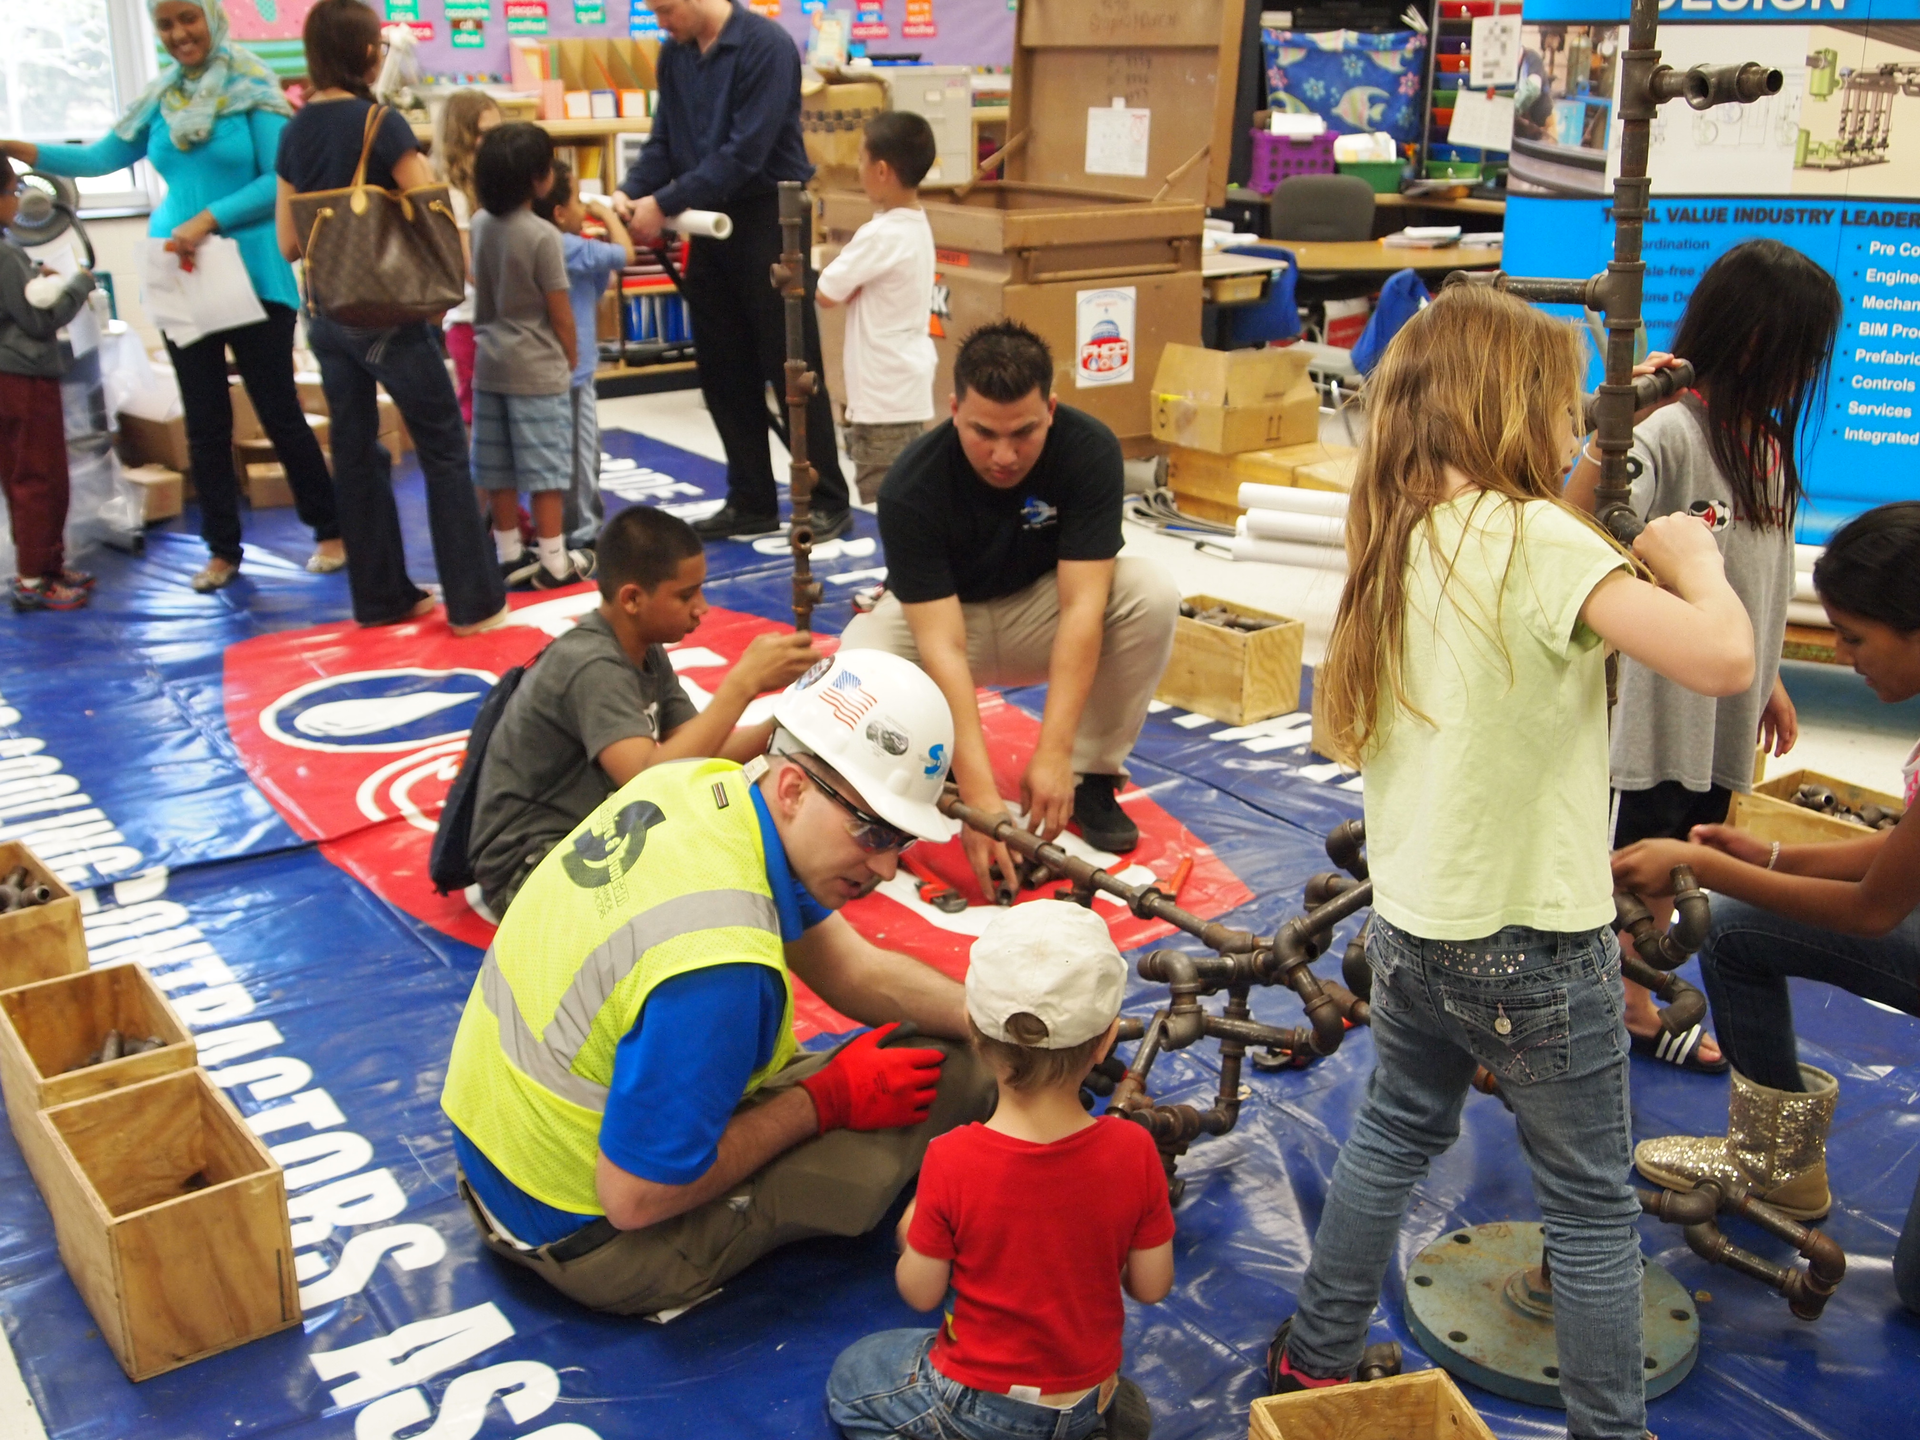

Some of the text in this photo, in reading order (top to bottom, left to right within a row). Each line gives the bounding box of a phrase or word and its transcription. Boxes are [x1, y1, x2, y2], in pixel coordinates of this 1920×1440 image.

[1602, 207, 1660, 223] TAL
[1666, 207, 1728, 224] VALUE
[1733, 208, 1835, 225] INDUSTRY
[1642, 239, 1710, 251] ordination
[1869, 240, 1896, 256] Pre
[1644, 265, 1696, 277] sle-free
[1865, 267, 1920, 287] Engine
[1858, 321, 1920, 340] BIM Pro
[1081, 341, 1129, 358] PHCC
[1851, 374, 1916, 393] Controls
[1848, 400, 1912, 419] Services
[1844, 426, 1920, 446] Integrated
[78, 865, 447, 1312] CONTRACTORS
